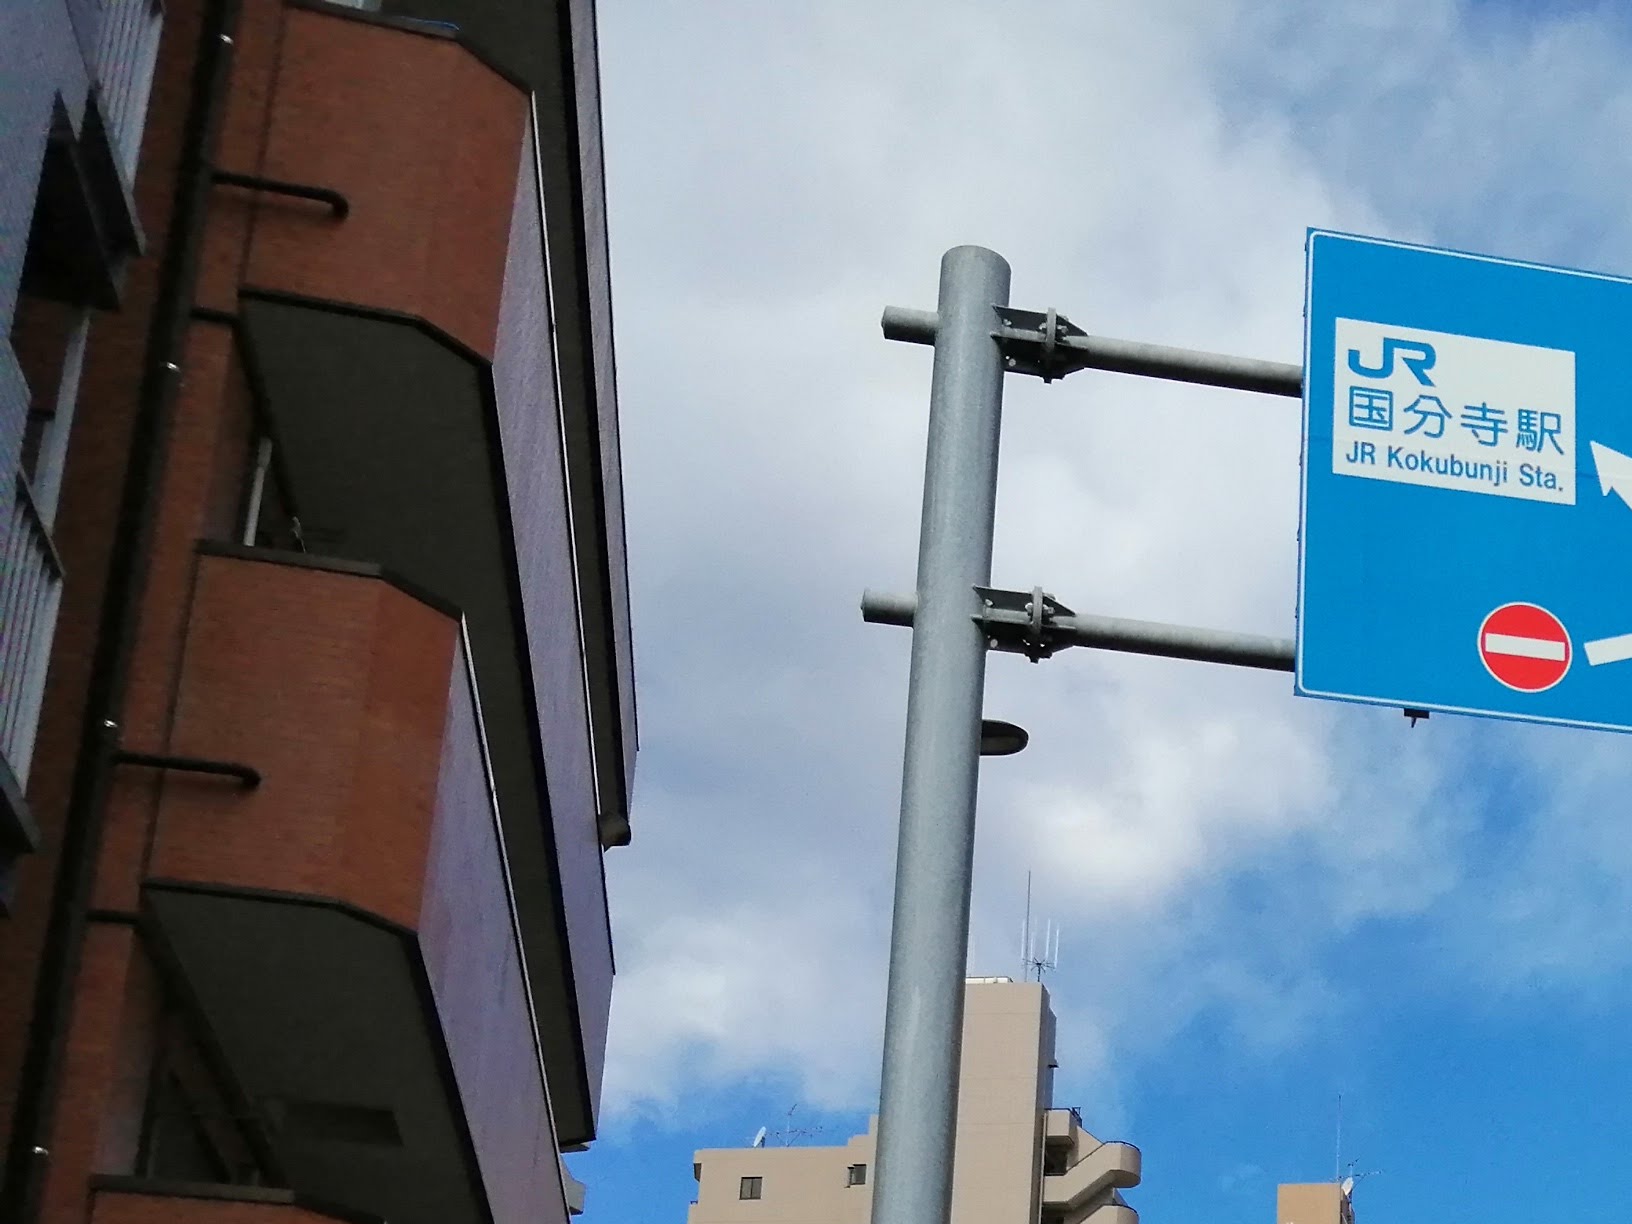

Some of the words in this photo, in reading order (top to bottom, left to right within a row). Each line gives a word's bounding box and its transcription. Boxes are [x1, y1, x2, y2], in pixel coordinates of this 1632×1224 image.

[1347, 337, 1437, 387] JR
[1349, 386, 1565, 456] 国分寺駅
[1346, 442, 1376, 466] JR
[1387, 445, 1509, 485] Kokubunji
[1520, 461, 1565, 492] Sta.
